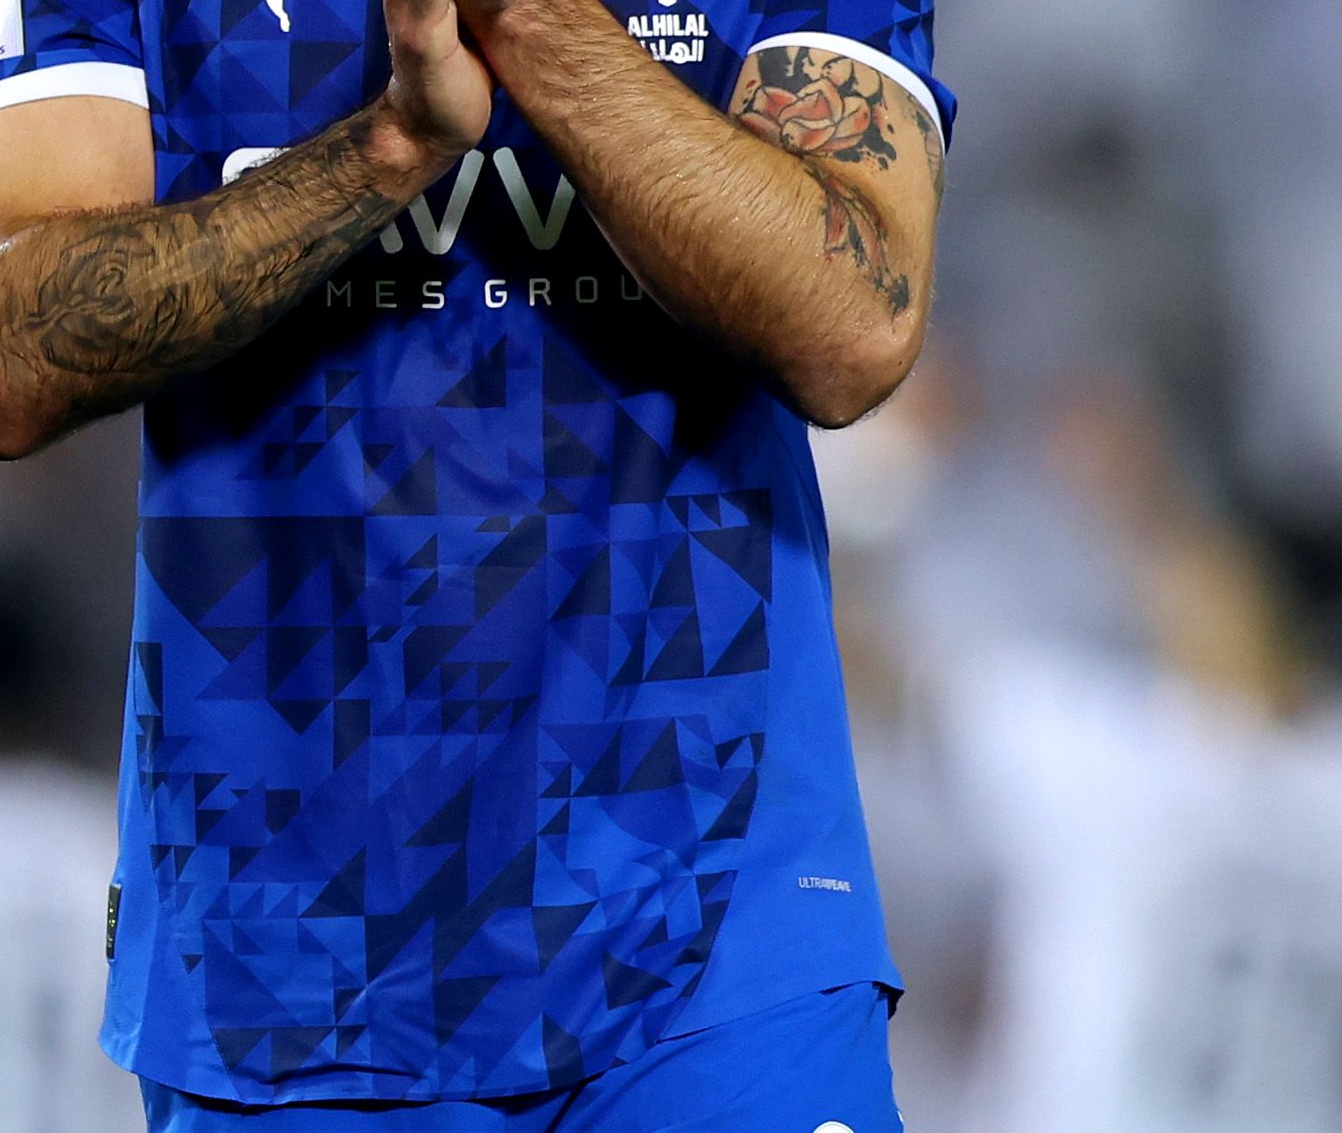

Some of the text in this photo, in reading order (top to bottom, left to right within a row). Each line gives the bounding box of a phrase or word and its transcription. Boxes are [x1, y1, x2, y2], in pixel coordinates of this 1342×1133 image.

[628, 13, 709, 38] ALHILAL
[325, 274, 647, 310] MES GROU
